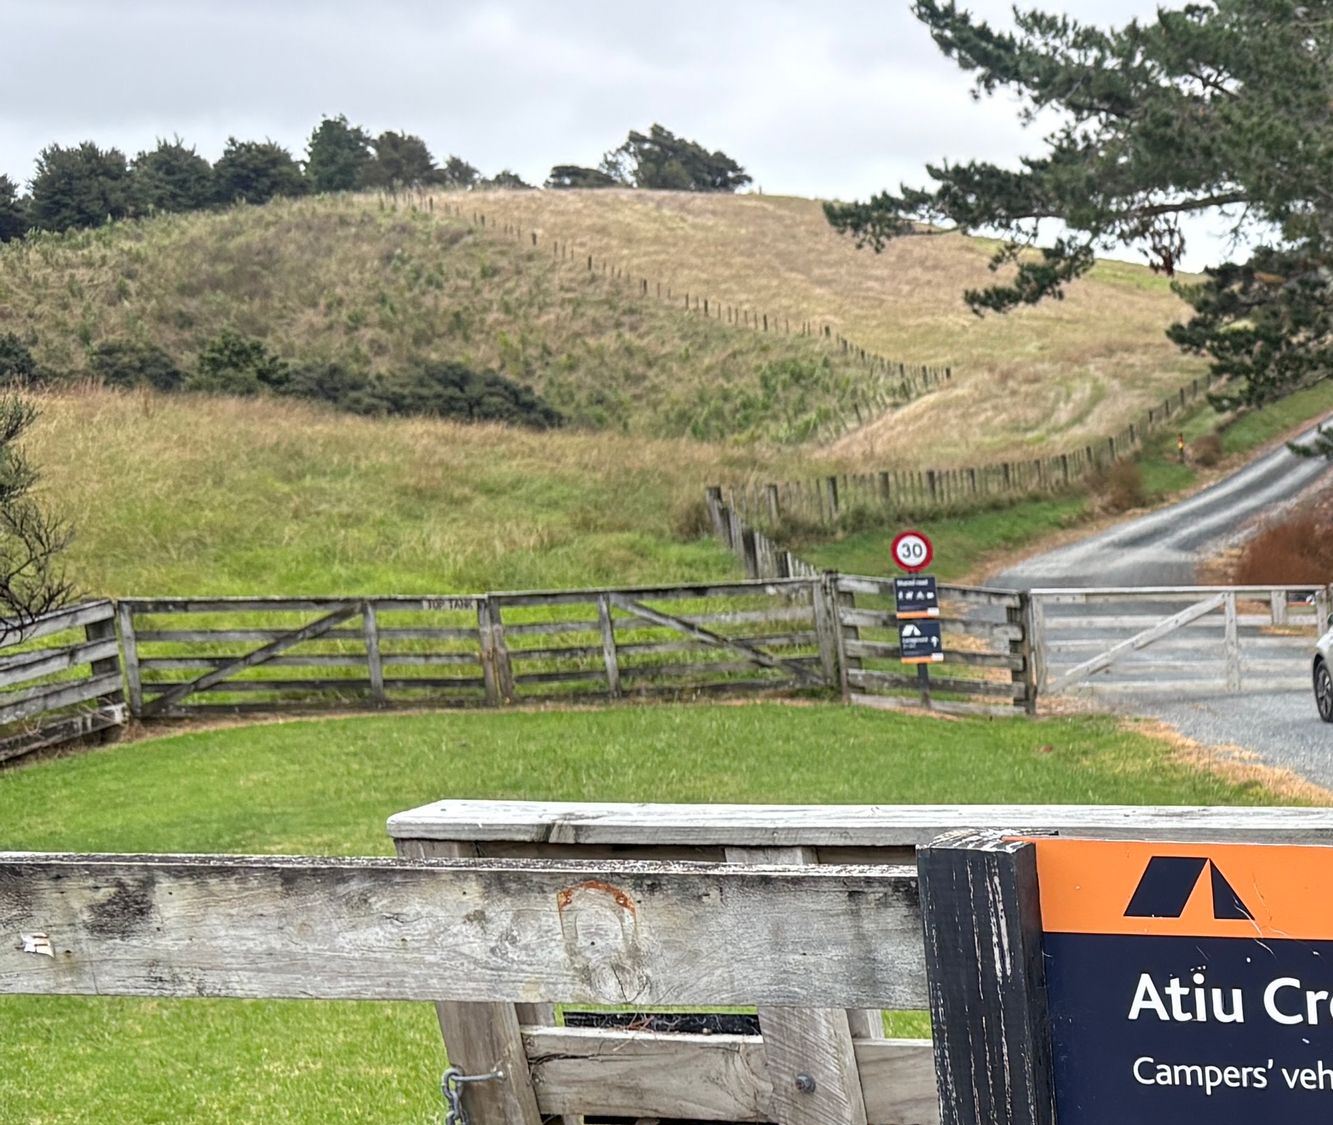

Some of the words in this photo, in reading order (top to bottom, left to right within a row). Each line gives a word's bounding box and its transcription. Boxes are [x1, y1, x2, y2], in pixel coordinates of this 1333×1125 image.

[902, 543, 922, 558] 30
[1128, 972, 1244, 1021] Atiu
[1132, 1057, 1274, 1089] Campers’
